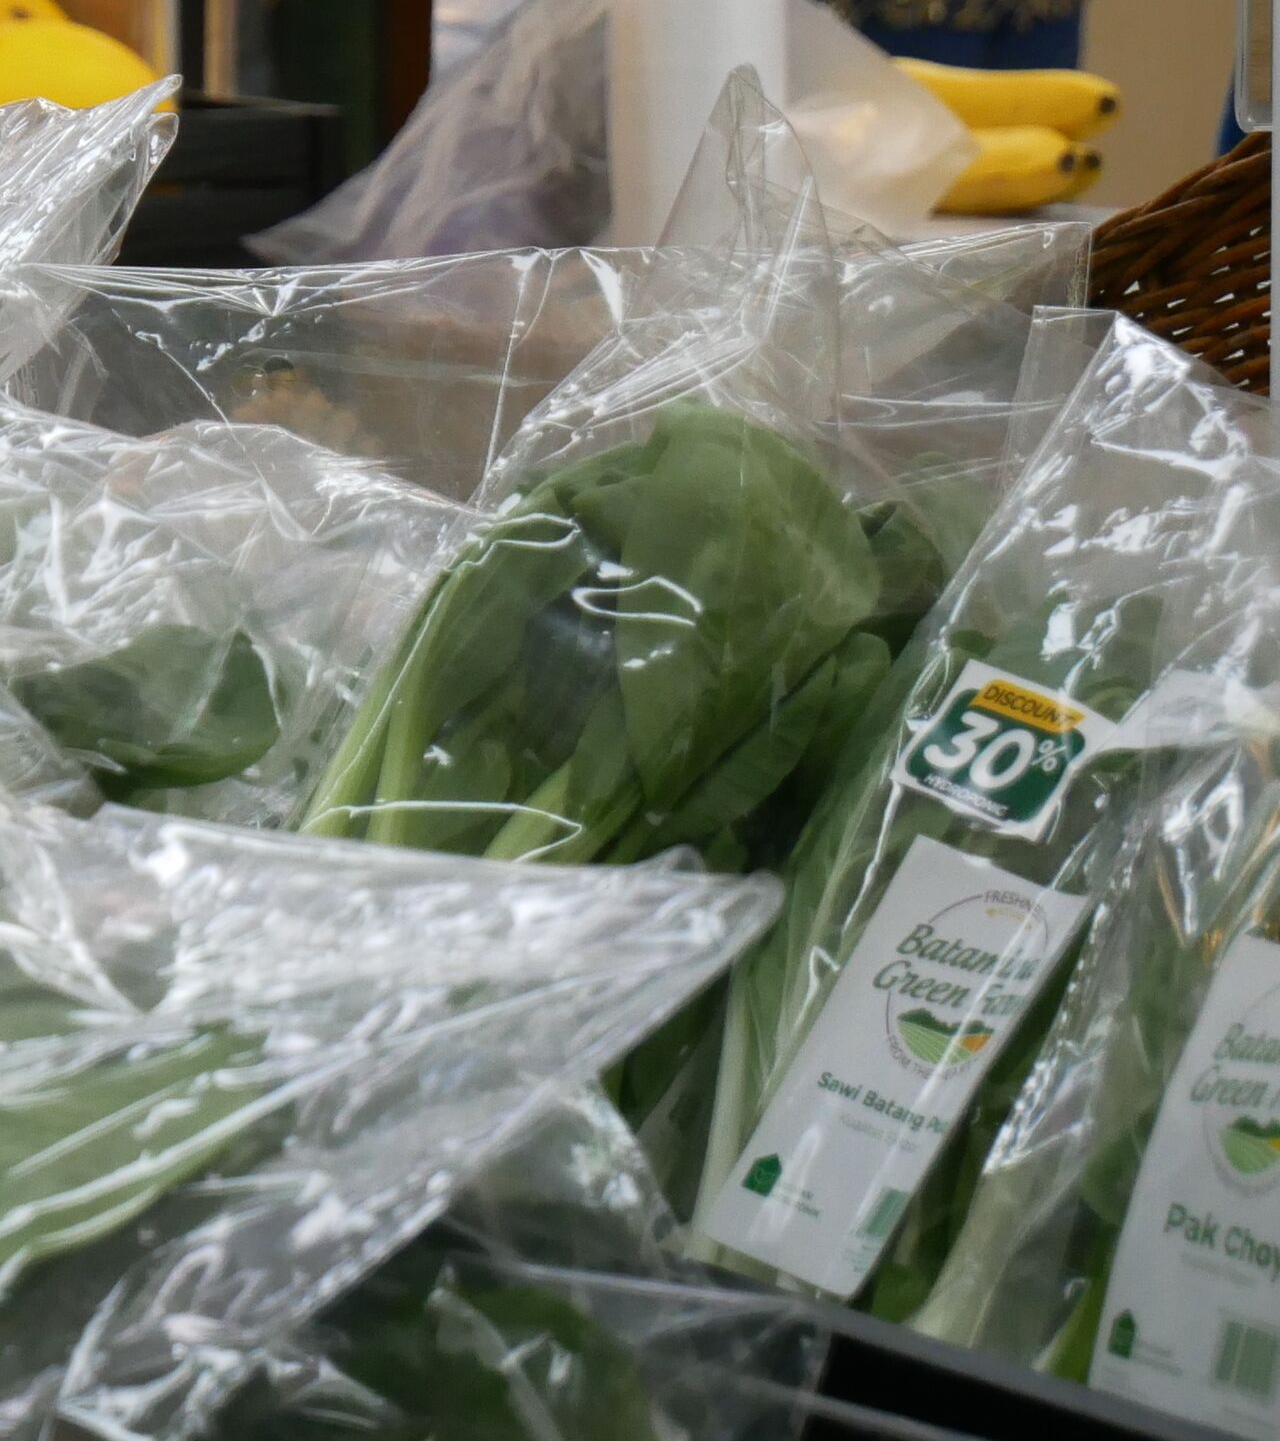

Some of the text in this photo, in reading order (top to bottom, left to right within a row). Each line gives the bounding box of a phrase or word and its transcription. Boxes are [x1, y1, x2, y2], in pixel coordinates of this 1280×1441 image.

[983, 684, 1075, 728] DISCOUNT
[923, 711, 1067, 789] 30%
[872, 959, 970, 1007] Green
[817, 1071, 863, 1100] Sawi
[862, 1089, 926, 1131] Batang
[1163, 1201, 1220, 1249] Pak
[1224, 1225, 1280, 1283] Choy
